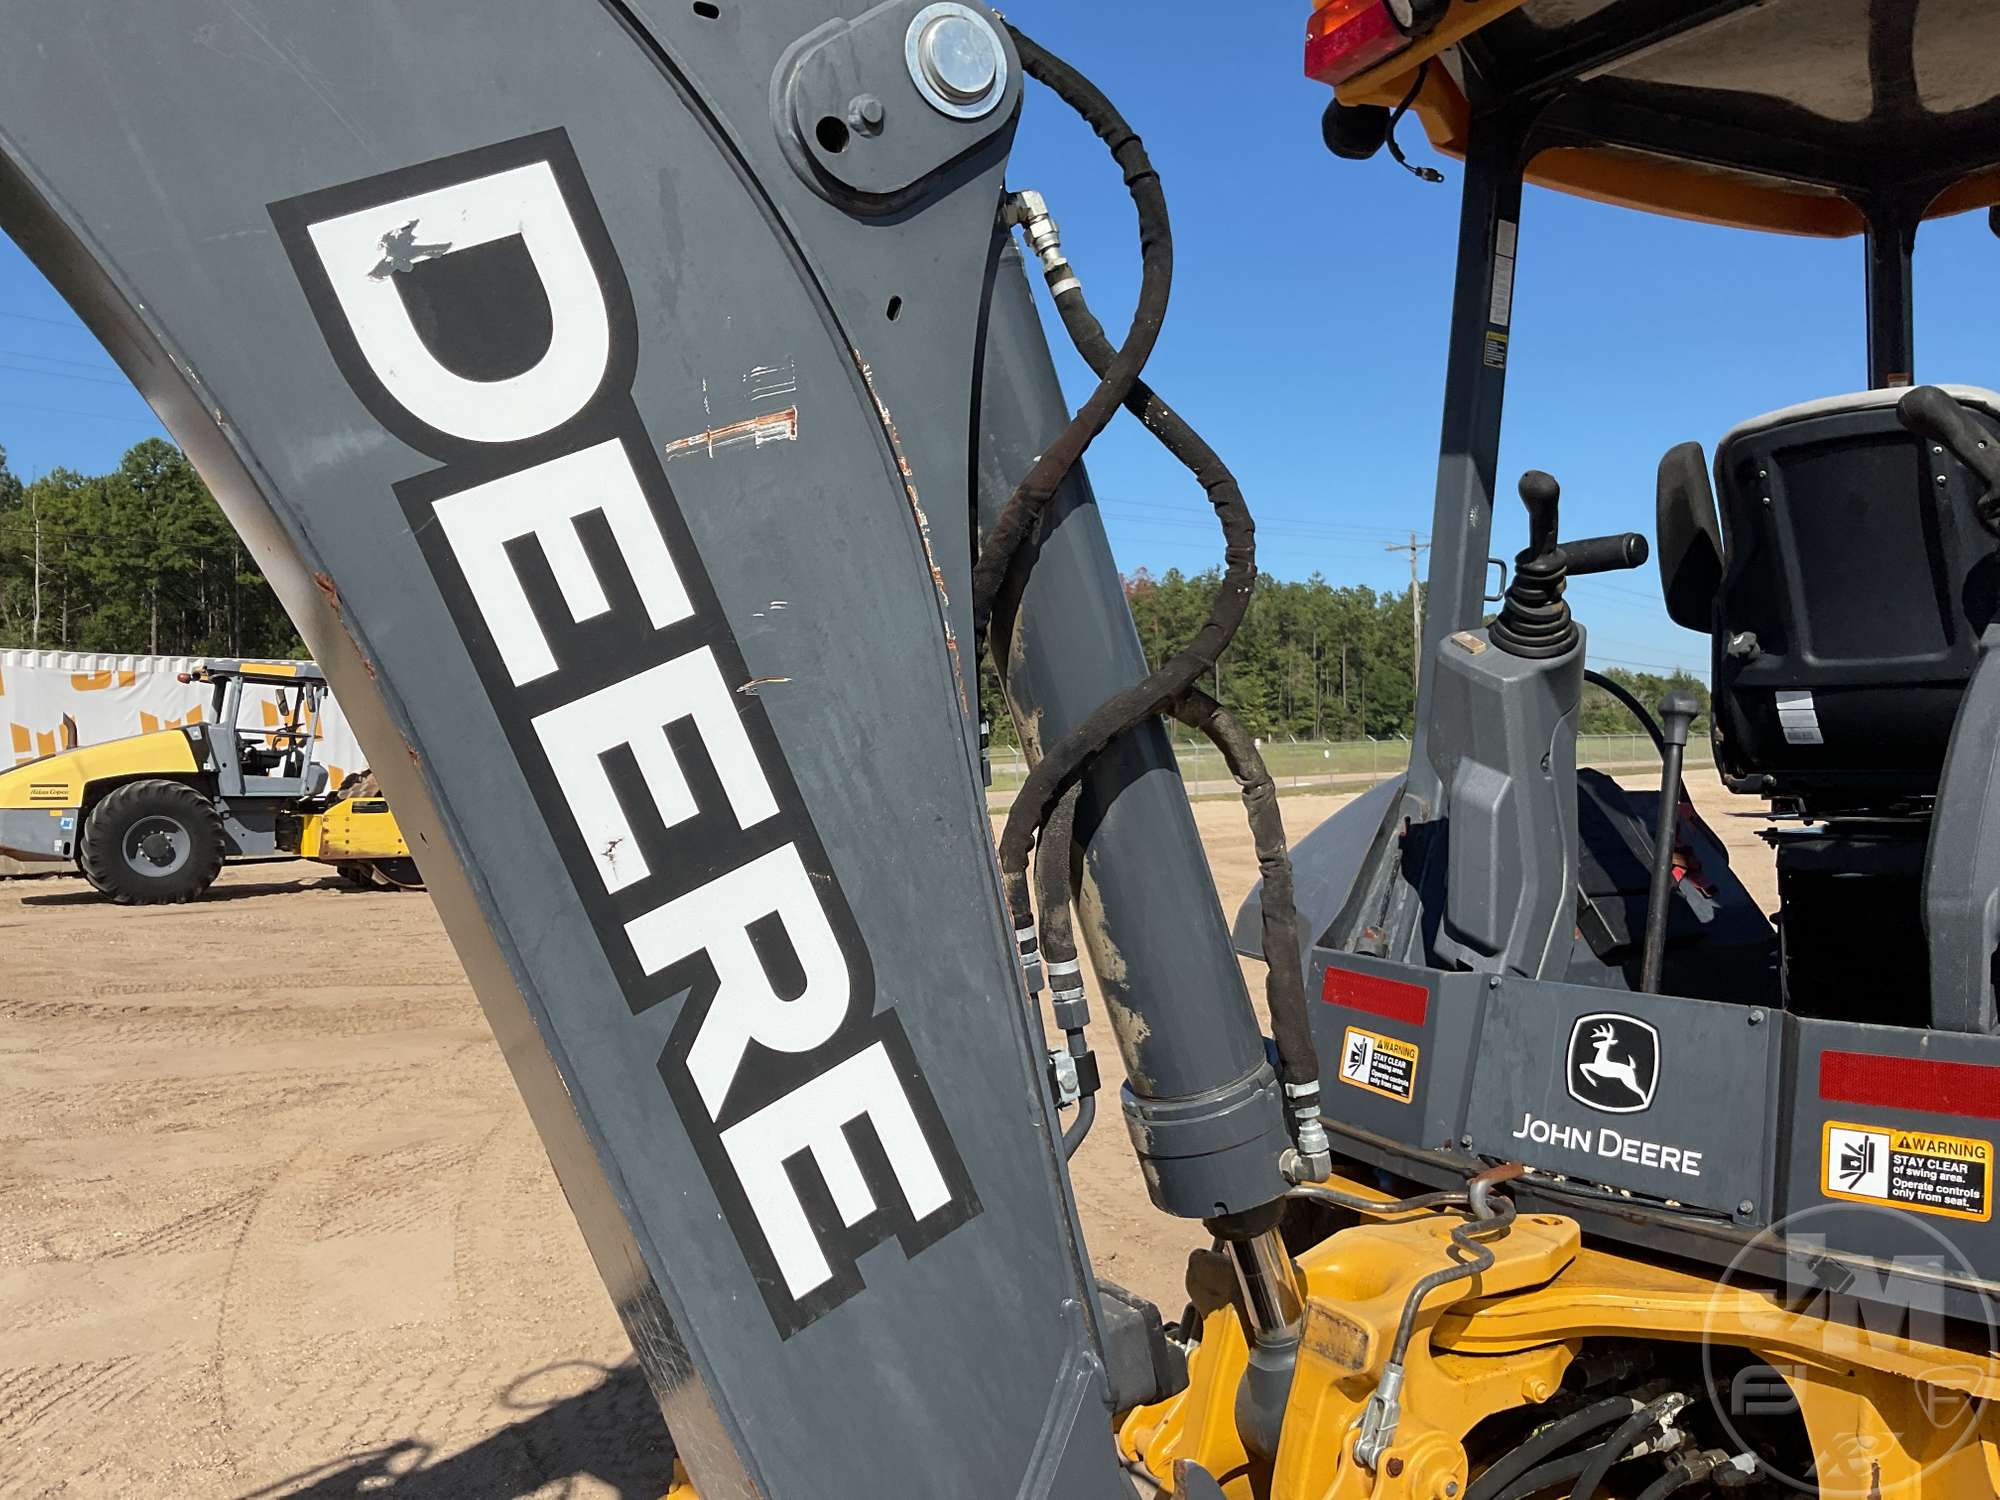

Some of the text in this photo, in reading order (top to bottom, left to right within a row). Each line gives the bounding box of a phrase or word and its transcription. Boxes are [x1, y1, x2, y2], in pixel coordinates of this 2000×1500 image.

[308, 159, 952, 1301] DEERE
[1384, 1040, 1415, 1058] WARNING
[1373, 1052, 1406, 1069] STAY CLEAR
[1371, 1069, 1389, 1080] Operate
[1512, 1112, 1702, 1177] JOHN DEERE
[1913, 1137, 1986, 1159] WARNING
[1893, 1154, 1968, 1173] STAY CLEAR
[1893, 1165, 1966, 1183] of swing area.
[1892, 1177, 1980, 1199] Operate controls
[1892, 1188, 1970, 1207] only from seat.
